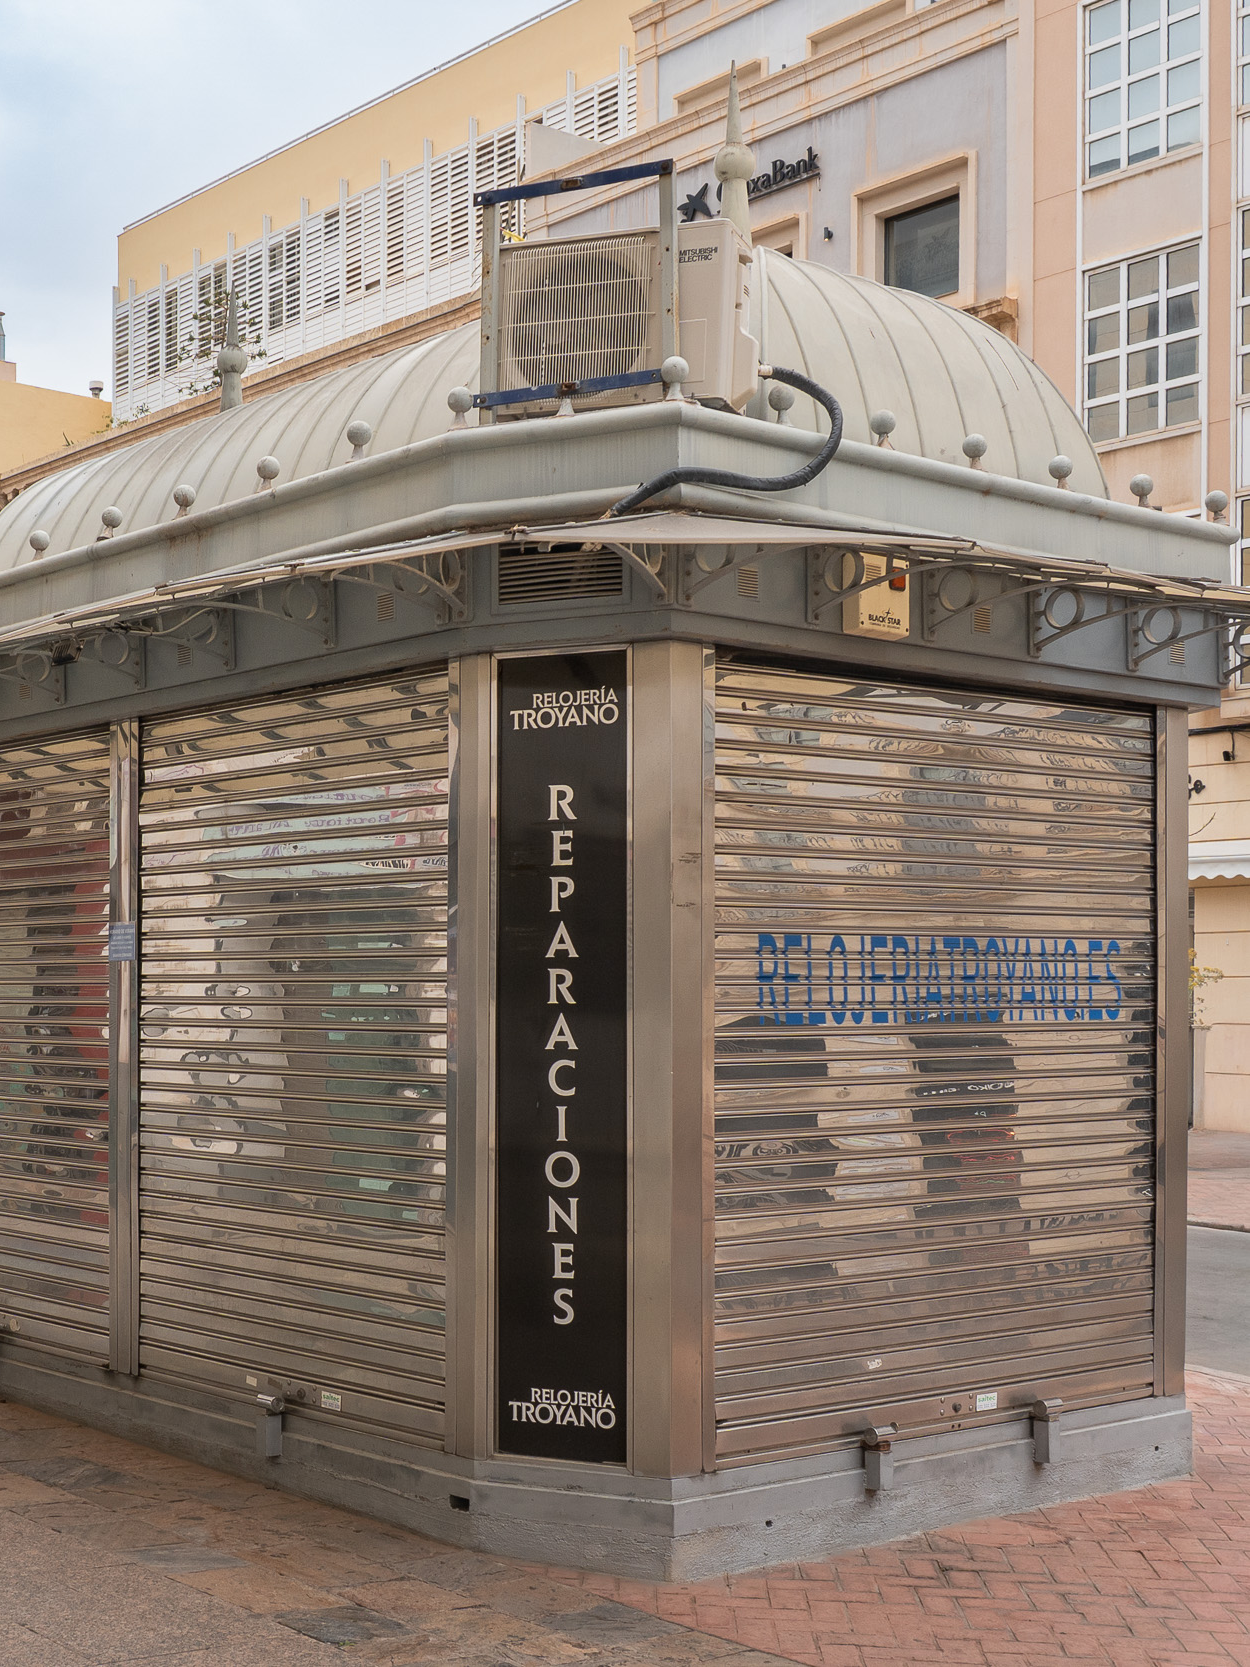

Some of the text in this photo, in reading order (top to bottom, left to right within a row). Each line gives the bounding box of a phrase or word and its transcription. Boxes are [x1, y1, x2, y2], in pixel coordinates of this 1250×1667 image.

[679, 246, 718, 257] MITSUBISHI
[679, 254, 713, 264] ELECTRIC
[868, 613, 887, 624] BLACK
[887, 617, 901, 626] STAR
[532, 685, 618, 709] RELOJERÍA
[509, 703, 619, 730] TROYANO
[544, 784, 581, 1325] REPARACIONES
[530, 1387, 616, 1409] RELOJERÍA
[508, 1401, 616, 1429] TROYANO
